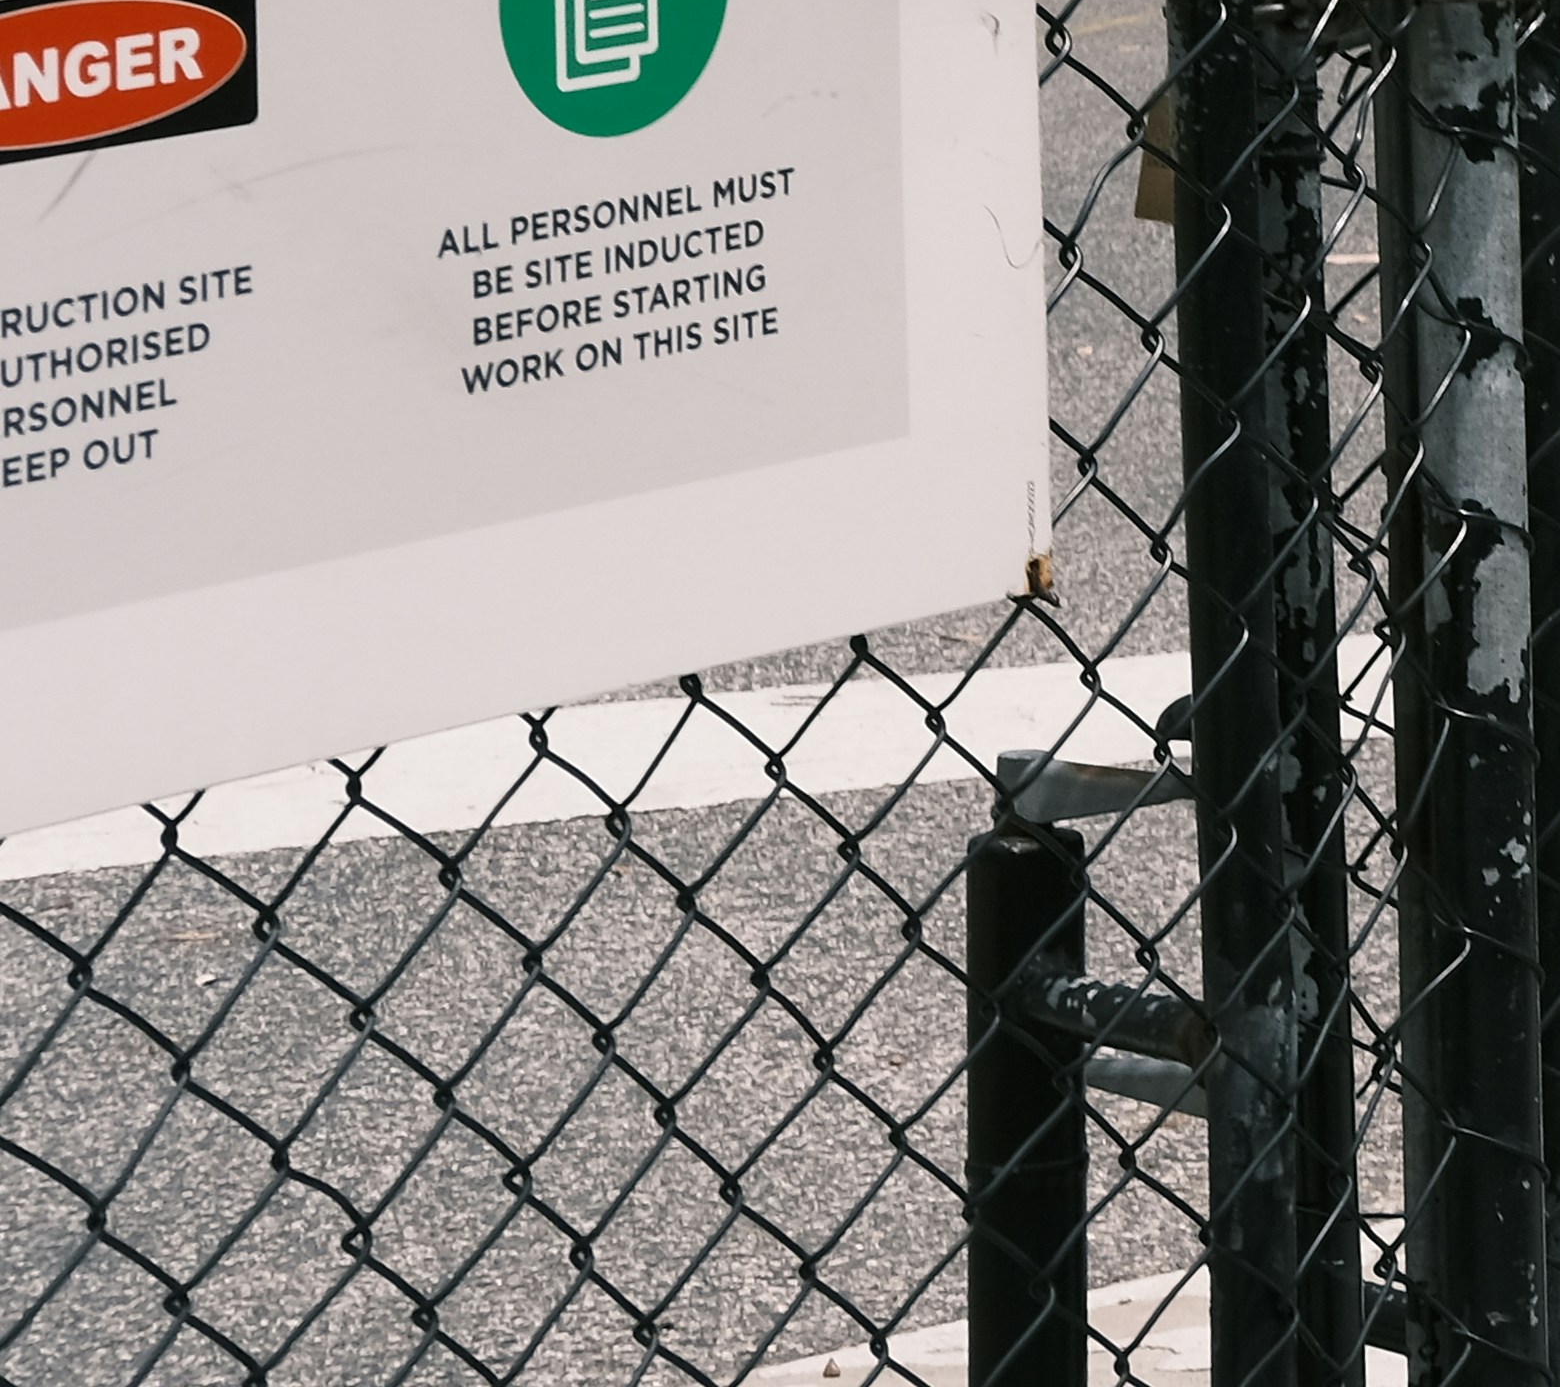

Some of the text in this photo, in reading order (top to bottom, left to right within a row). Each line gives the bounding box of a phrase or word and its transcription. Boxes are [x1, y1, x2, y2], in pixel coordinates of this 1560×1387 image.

[437, 167, 795, 259] ALL PERSONNEL MUST
[472, 219, 765, 300] BE SITE INDUCTED
[0, 264, 254, 339] RUCTION SITE
[472, 263, 767, 346] BEFORE STARTING
[0, 322, 211, 388] UTHORISED
[461, 306, 779, 396] WORK ON THIS SITE
[2, 377, 178, 438] RSONNEL
[2, 428, 160, 489] EEP OUT
